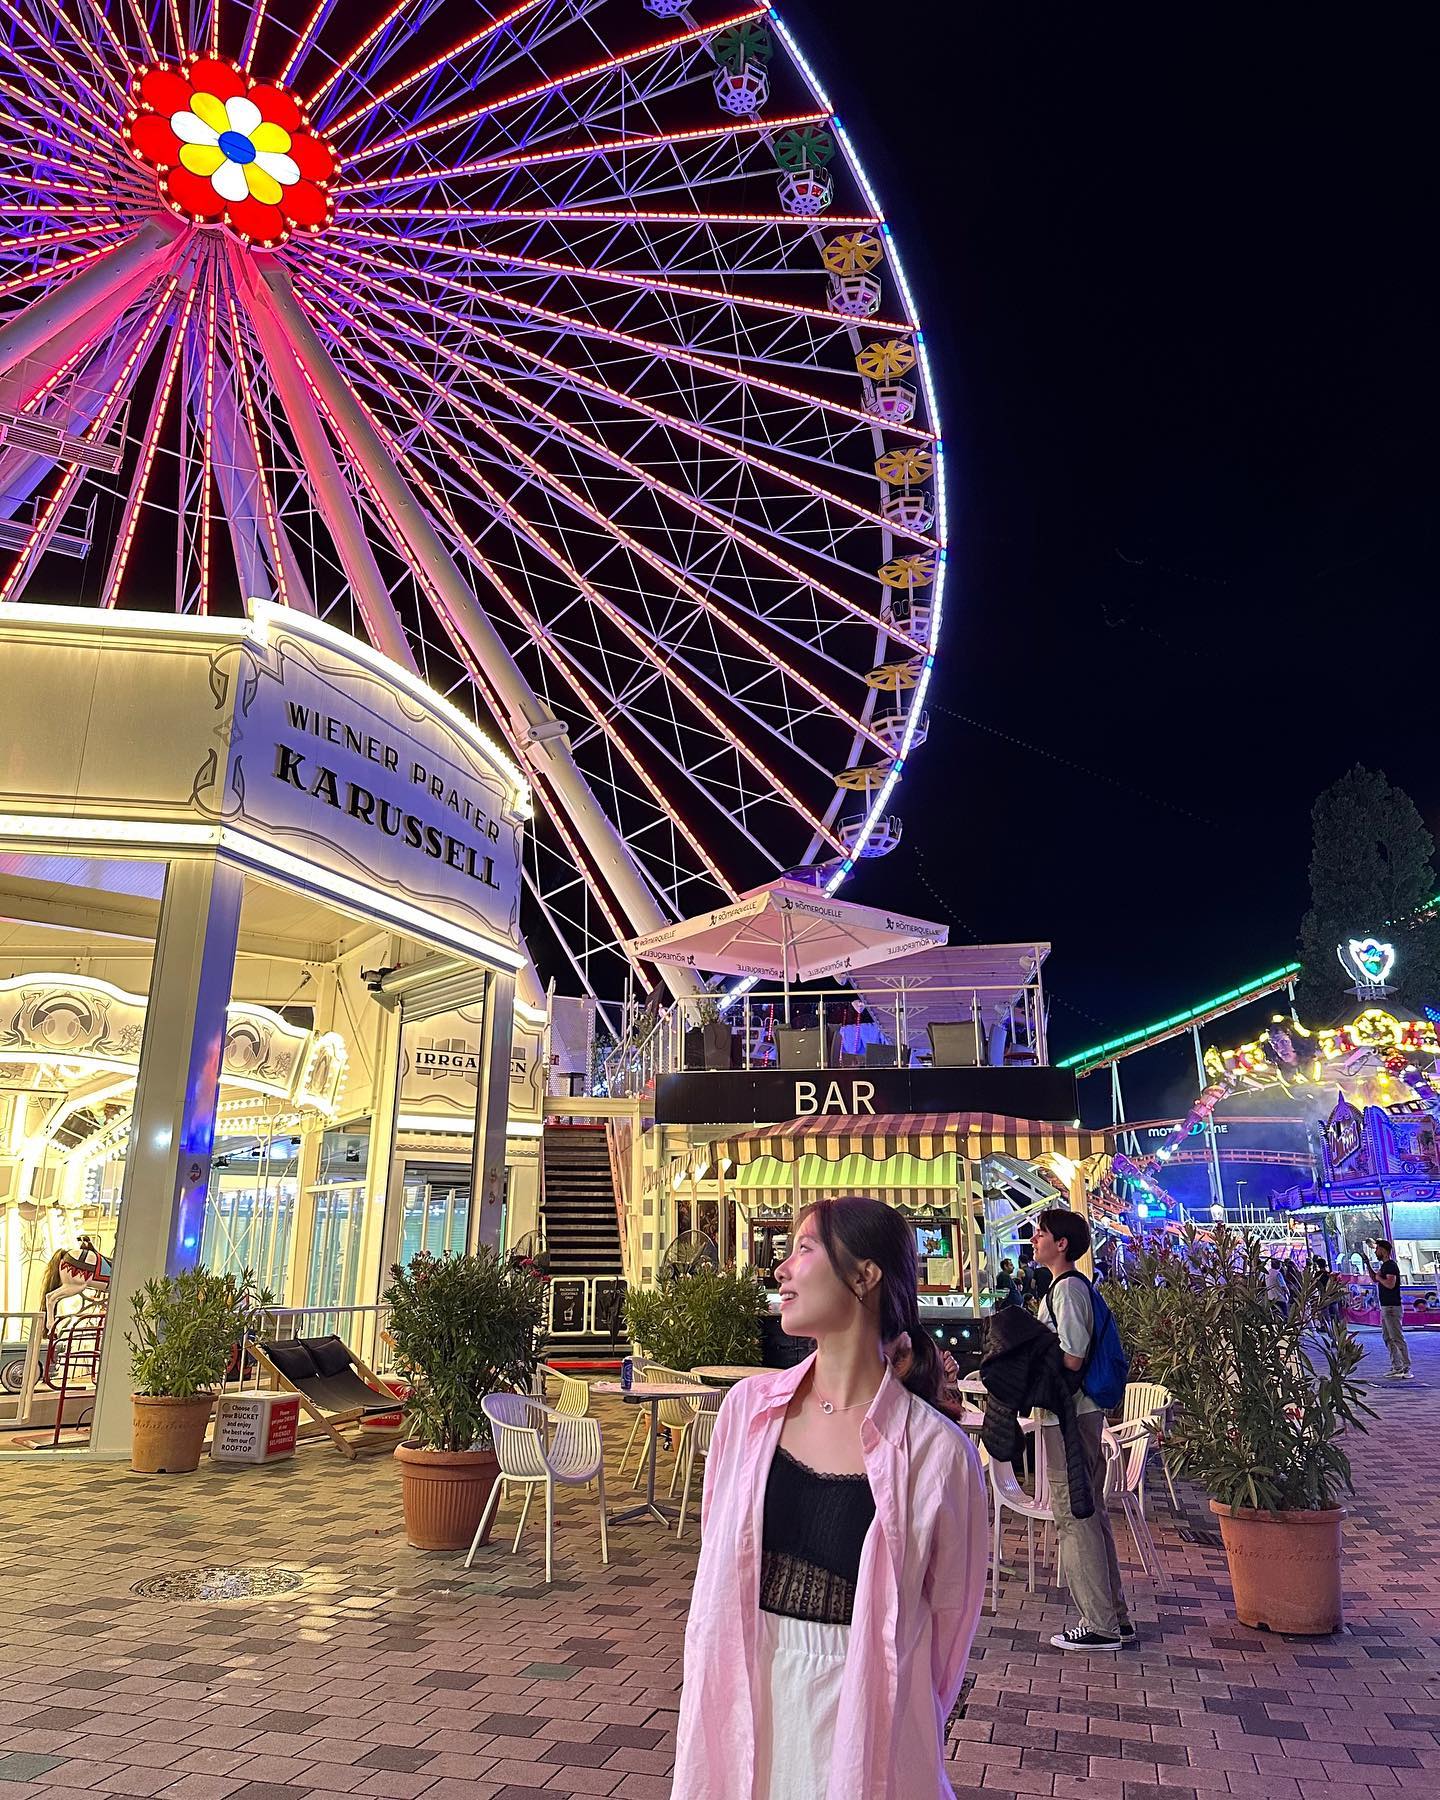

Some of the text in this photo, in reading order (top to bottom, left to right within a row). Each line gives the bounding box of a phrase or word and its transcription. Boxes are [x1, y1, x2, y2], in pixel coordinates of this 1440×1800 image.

[275, 743, 500, 891] KARUSSELL
[286, 701, 500, 844] WIENER PRATER
[795, 1080, 876, 1116] BAR
[221, 1444, 252, 1452] ROOFTOP
